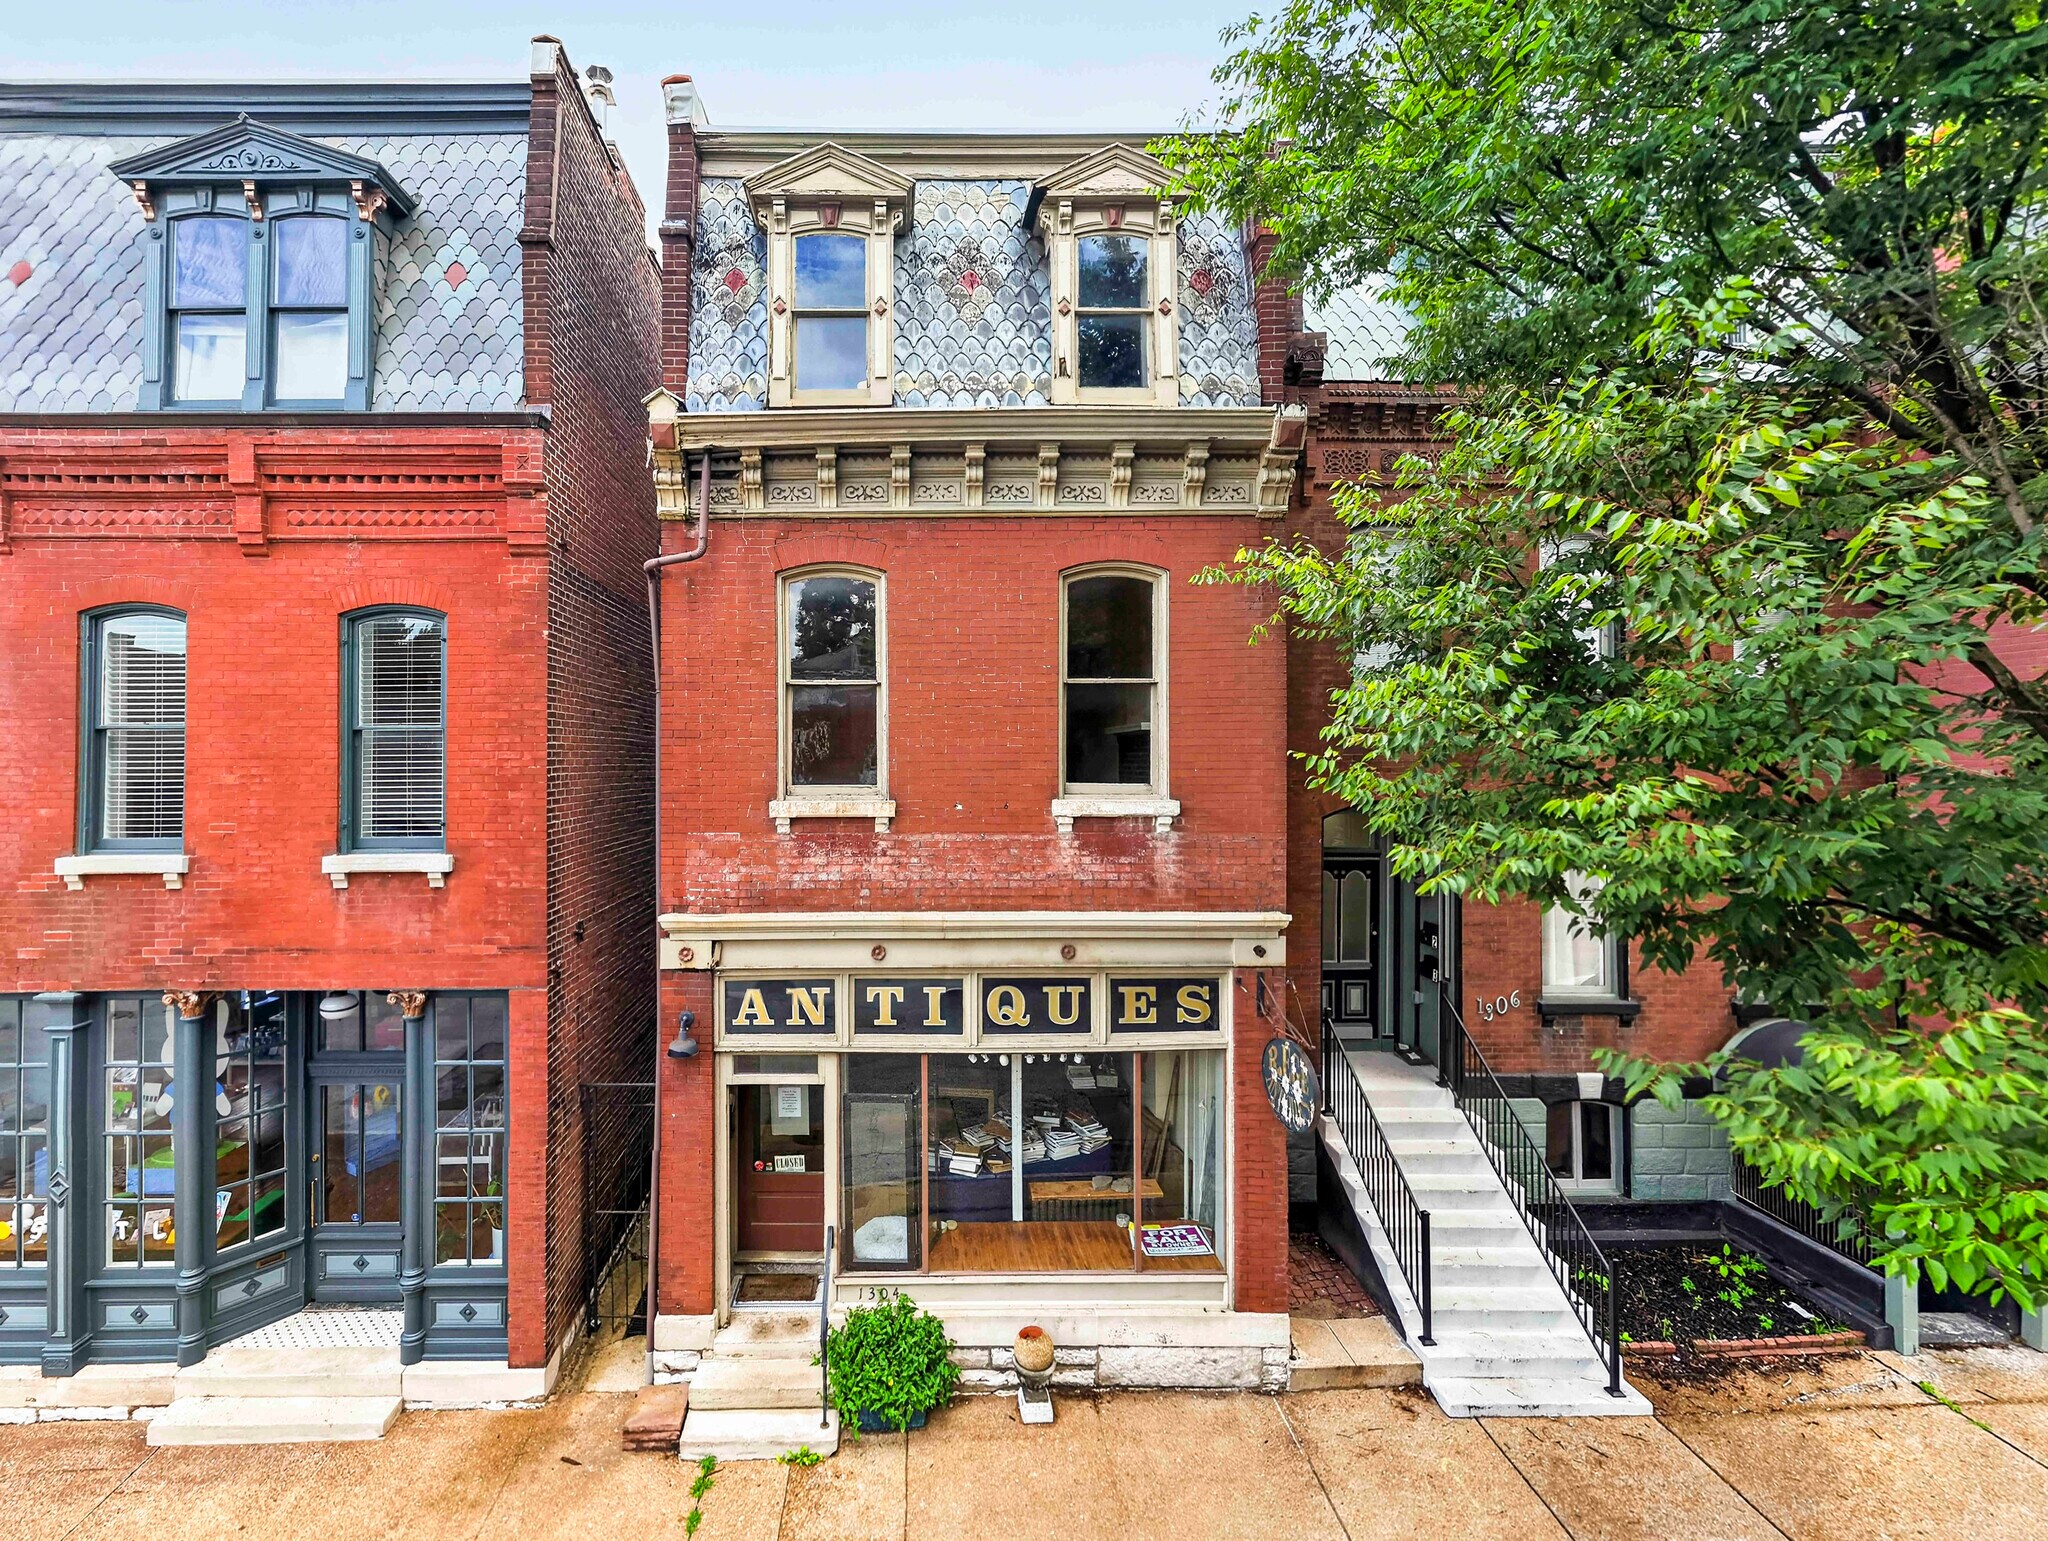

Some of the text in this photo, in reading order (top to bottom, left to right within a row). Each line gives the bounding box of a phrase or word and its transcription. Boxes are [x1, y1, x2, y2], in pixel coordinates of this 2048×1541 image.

[732, 985, 1213, 1027] ANTIQUES
[1476, 989, 1521, 1021] 1306
[776, 1158, 804, 1168] CLOSED
[1147, 1229, 1188, 1237] FOR
[1143, 1235, 1200, 1244] SALE
[858, 1287, 899, 1300] 1304
